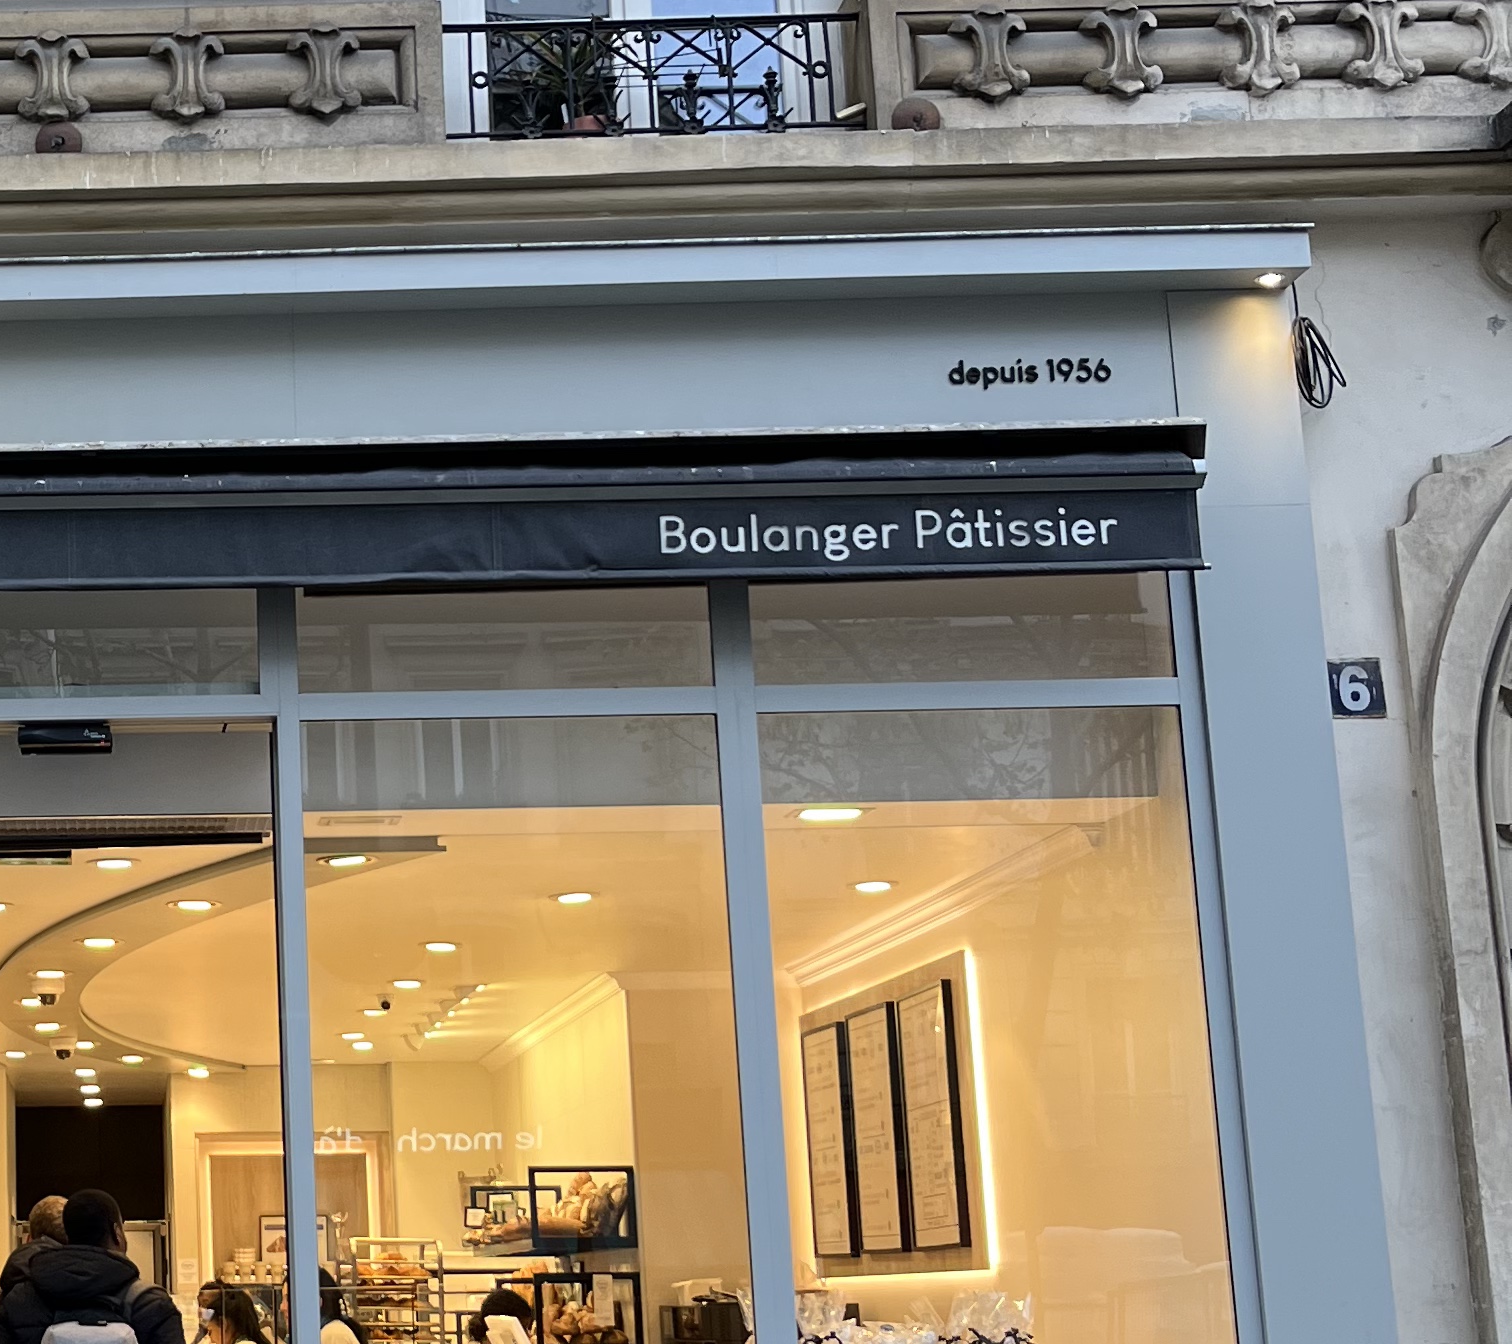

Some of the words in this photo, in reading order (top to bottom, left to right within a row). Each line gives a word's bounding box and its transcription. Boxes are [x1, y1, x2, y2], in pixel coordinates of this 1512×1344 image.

[947, 357, 1040, 391] depuis
[1045, 356, 1113, 384] 1956
[658, 513, 900, 563] Boulanger
[915, 506, 1119, 550] Pâtissier
[1339, 665, 1371, 712] 6
